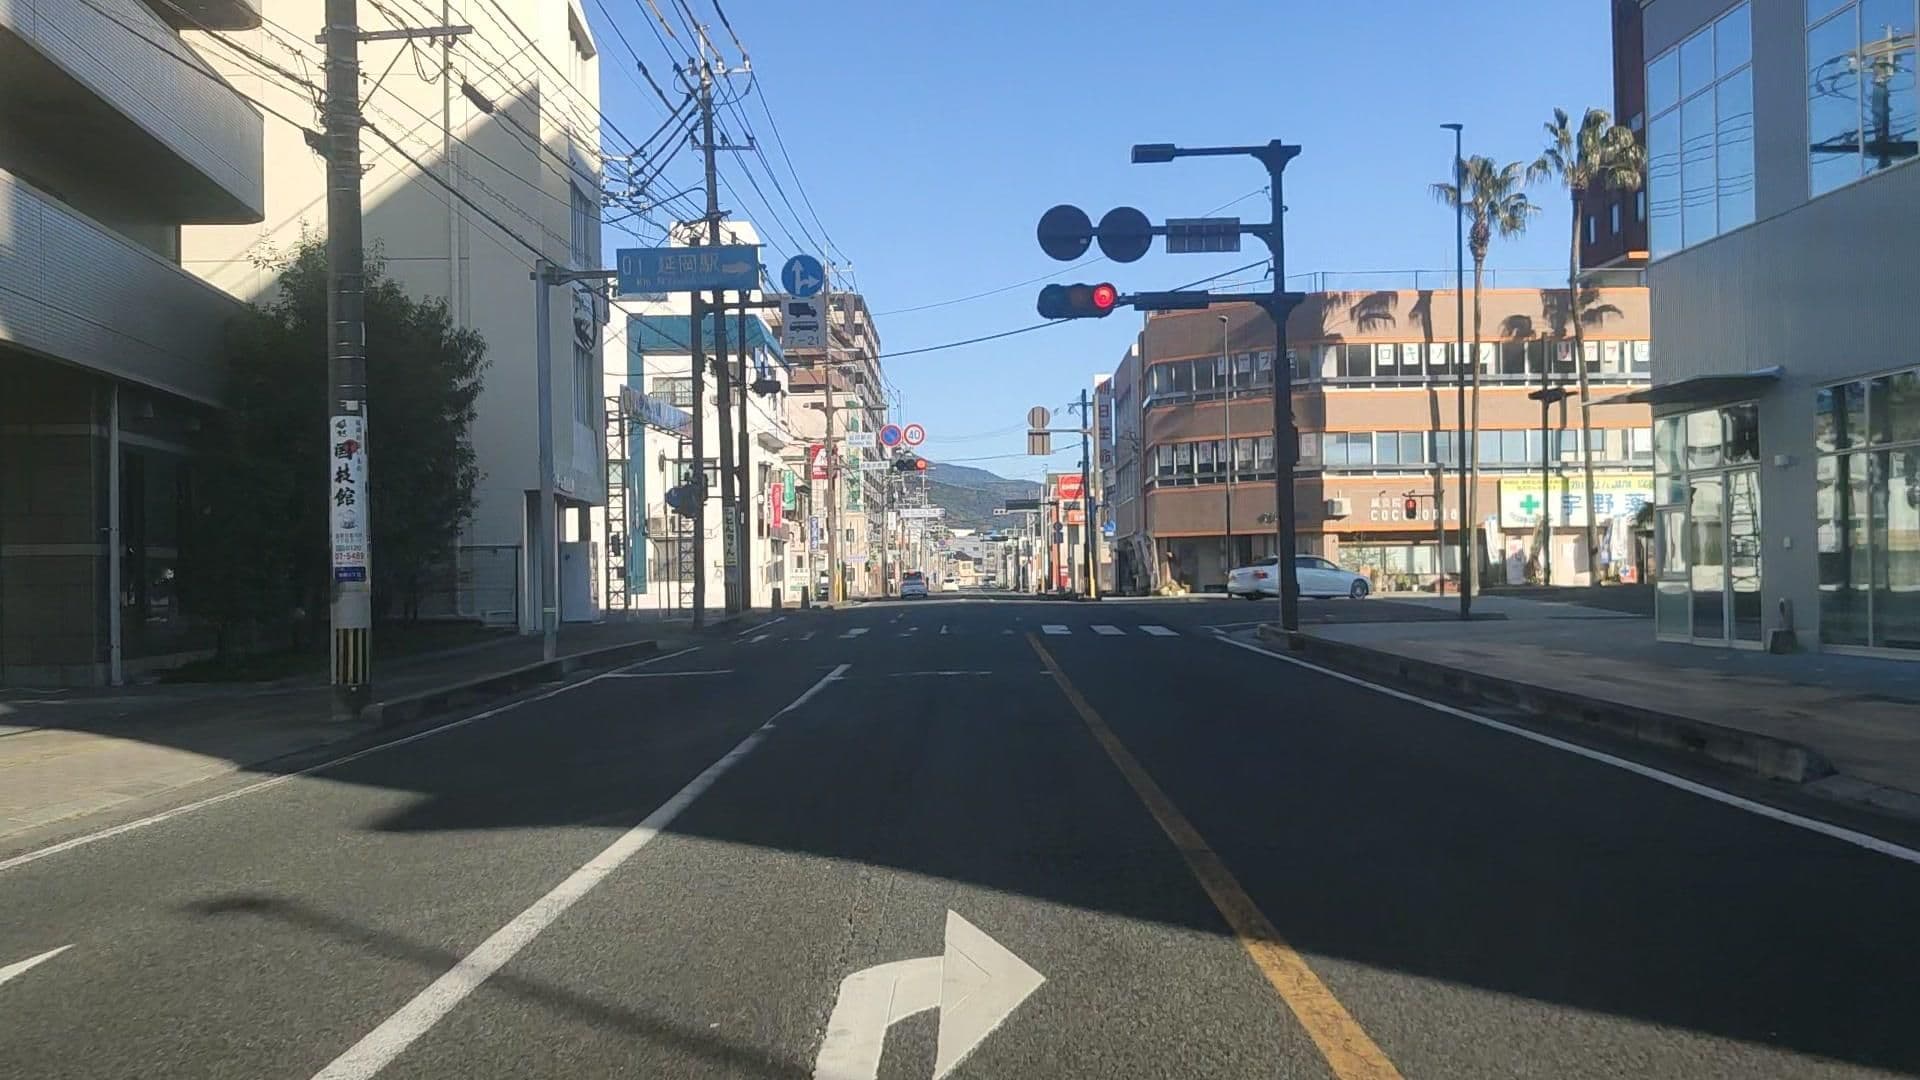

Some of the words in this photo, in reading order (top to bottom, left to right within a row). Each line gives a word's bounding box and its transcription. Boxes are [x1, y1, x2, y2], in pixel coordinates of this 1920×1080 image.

[908, 430, 921, 442] 40
[334, 442, 356, 506] 国技館
